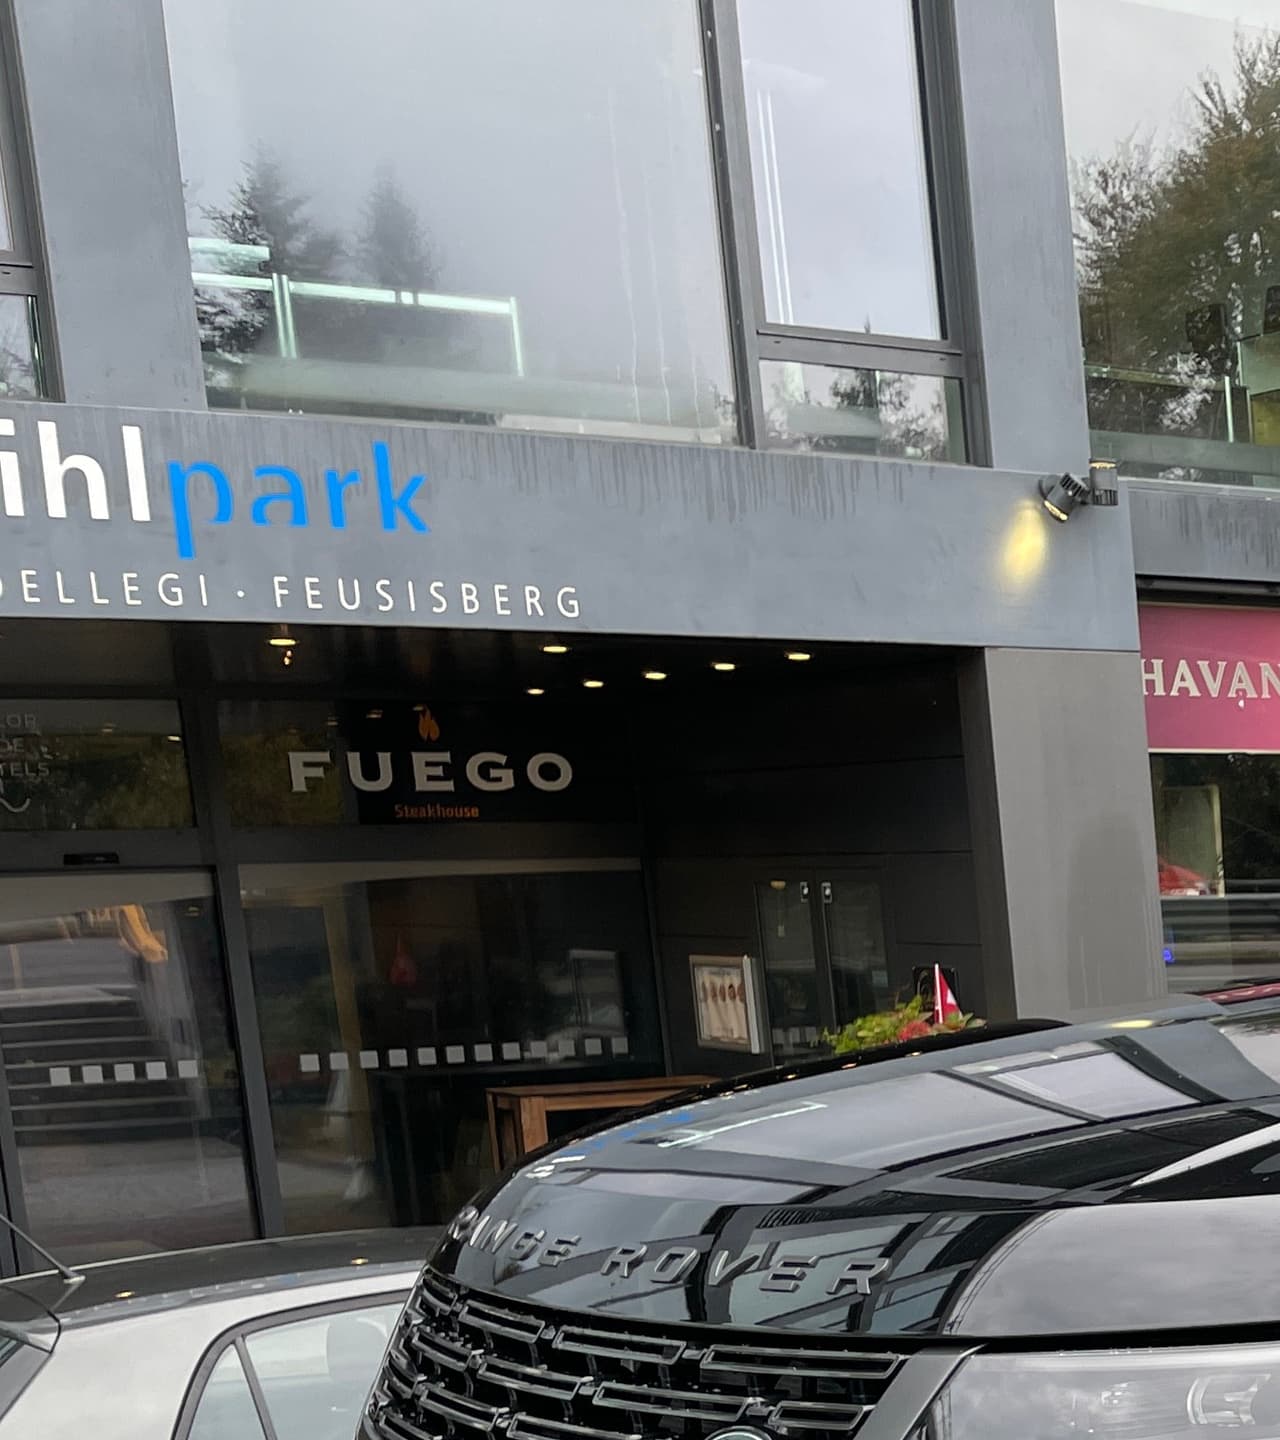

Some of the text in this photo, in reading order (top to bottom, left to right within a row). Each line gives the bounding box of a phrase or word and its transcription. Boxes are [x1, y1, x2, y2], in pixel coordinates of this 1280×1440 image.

[0, 569, 582, 619] ELLEGI FEUSISBERG
[288, 750, 574, 793] FUEGO
[394, 803, 480, 819] Steakhouse
[600, 1242, 890, 1296] ROVER
